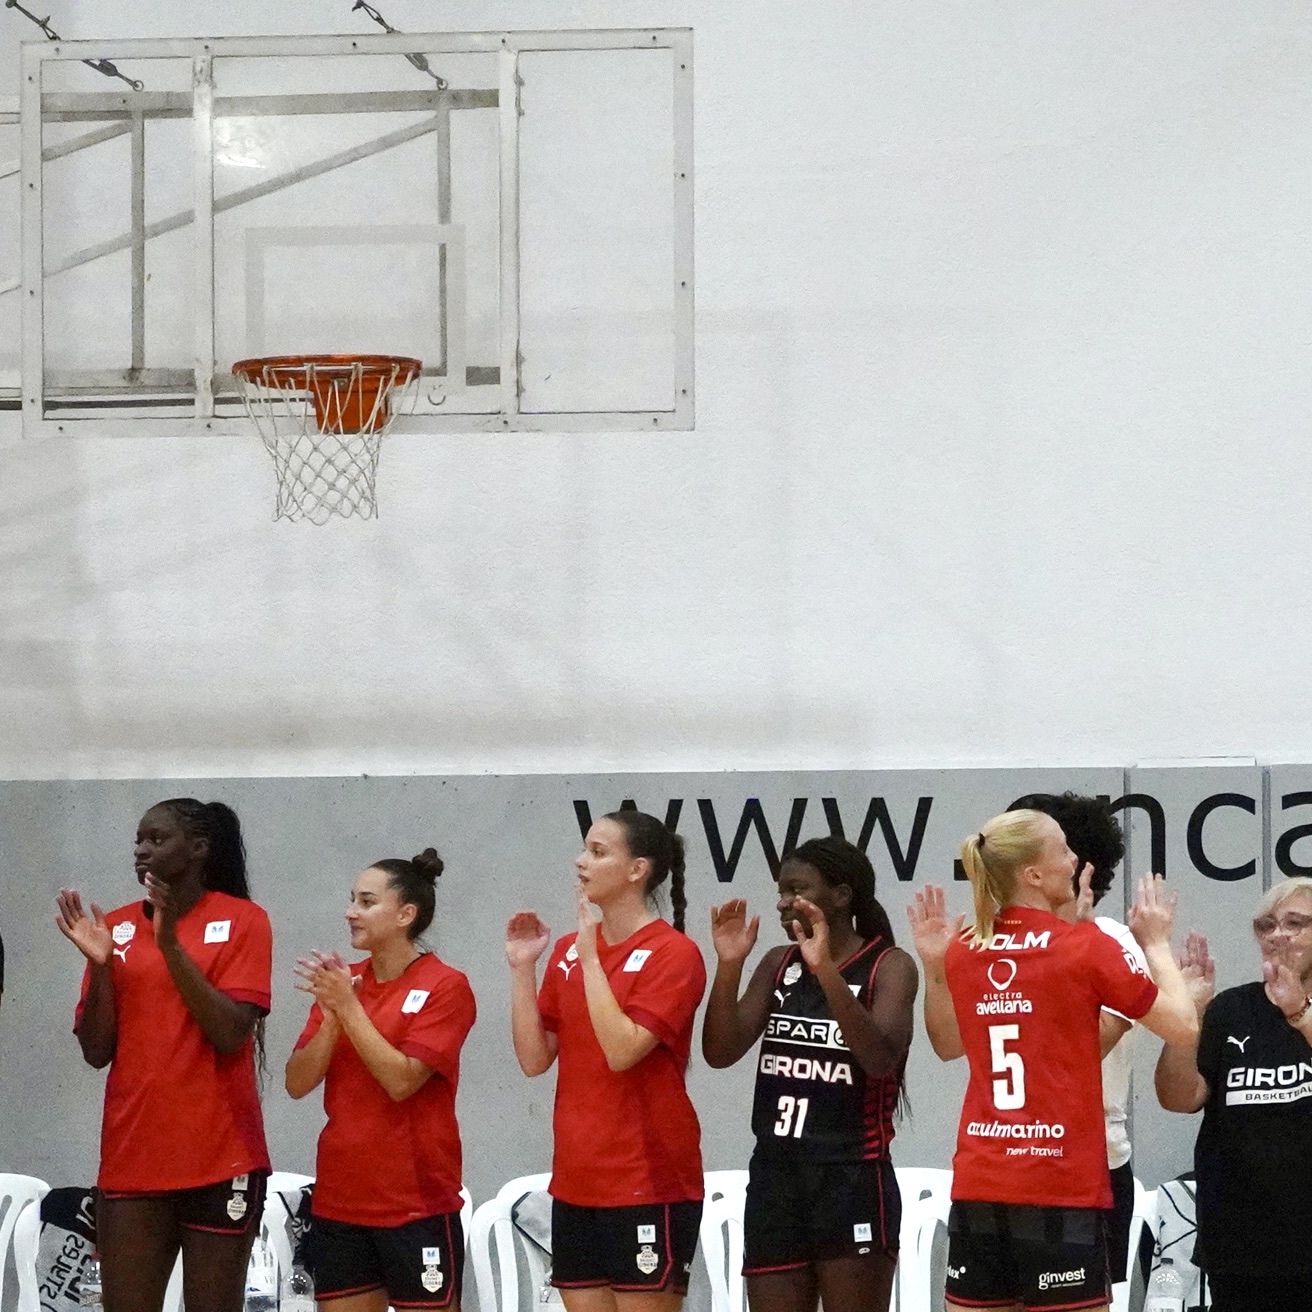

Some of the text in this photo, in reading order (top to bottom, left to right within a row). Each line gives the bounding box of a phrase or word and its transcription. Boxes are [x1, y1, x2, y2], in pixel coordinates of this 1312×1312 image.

[969, 931, 1052, 951] OLM
[983, 992, 1023, 1000] electra
[976, 999, 1033, 1016] avellana
[767, 1020, 828, 1041] SPAR
[760, 1053, 853, 1086] GIRONA
[988, 1024, 1026, 1111] 5
[773, 1095, 809, 1139] 31
[967, 1120, 1065, 1139] azulmarino
[1006, 1145, 1063, 1157] new travel
[1038, 1267, 1086, 1290] ginvest
